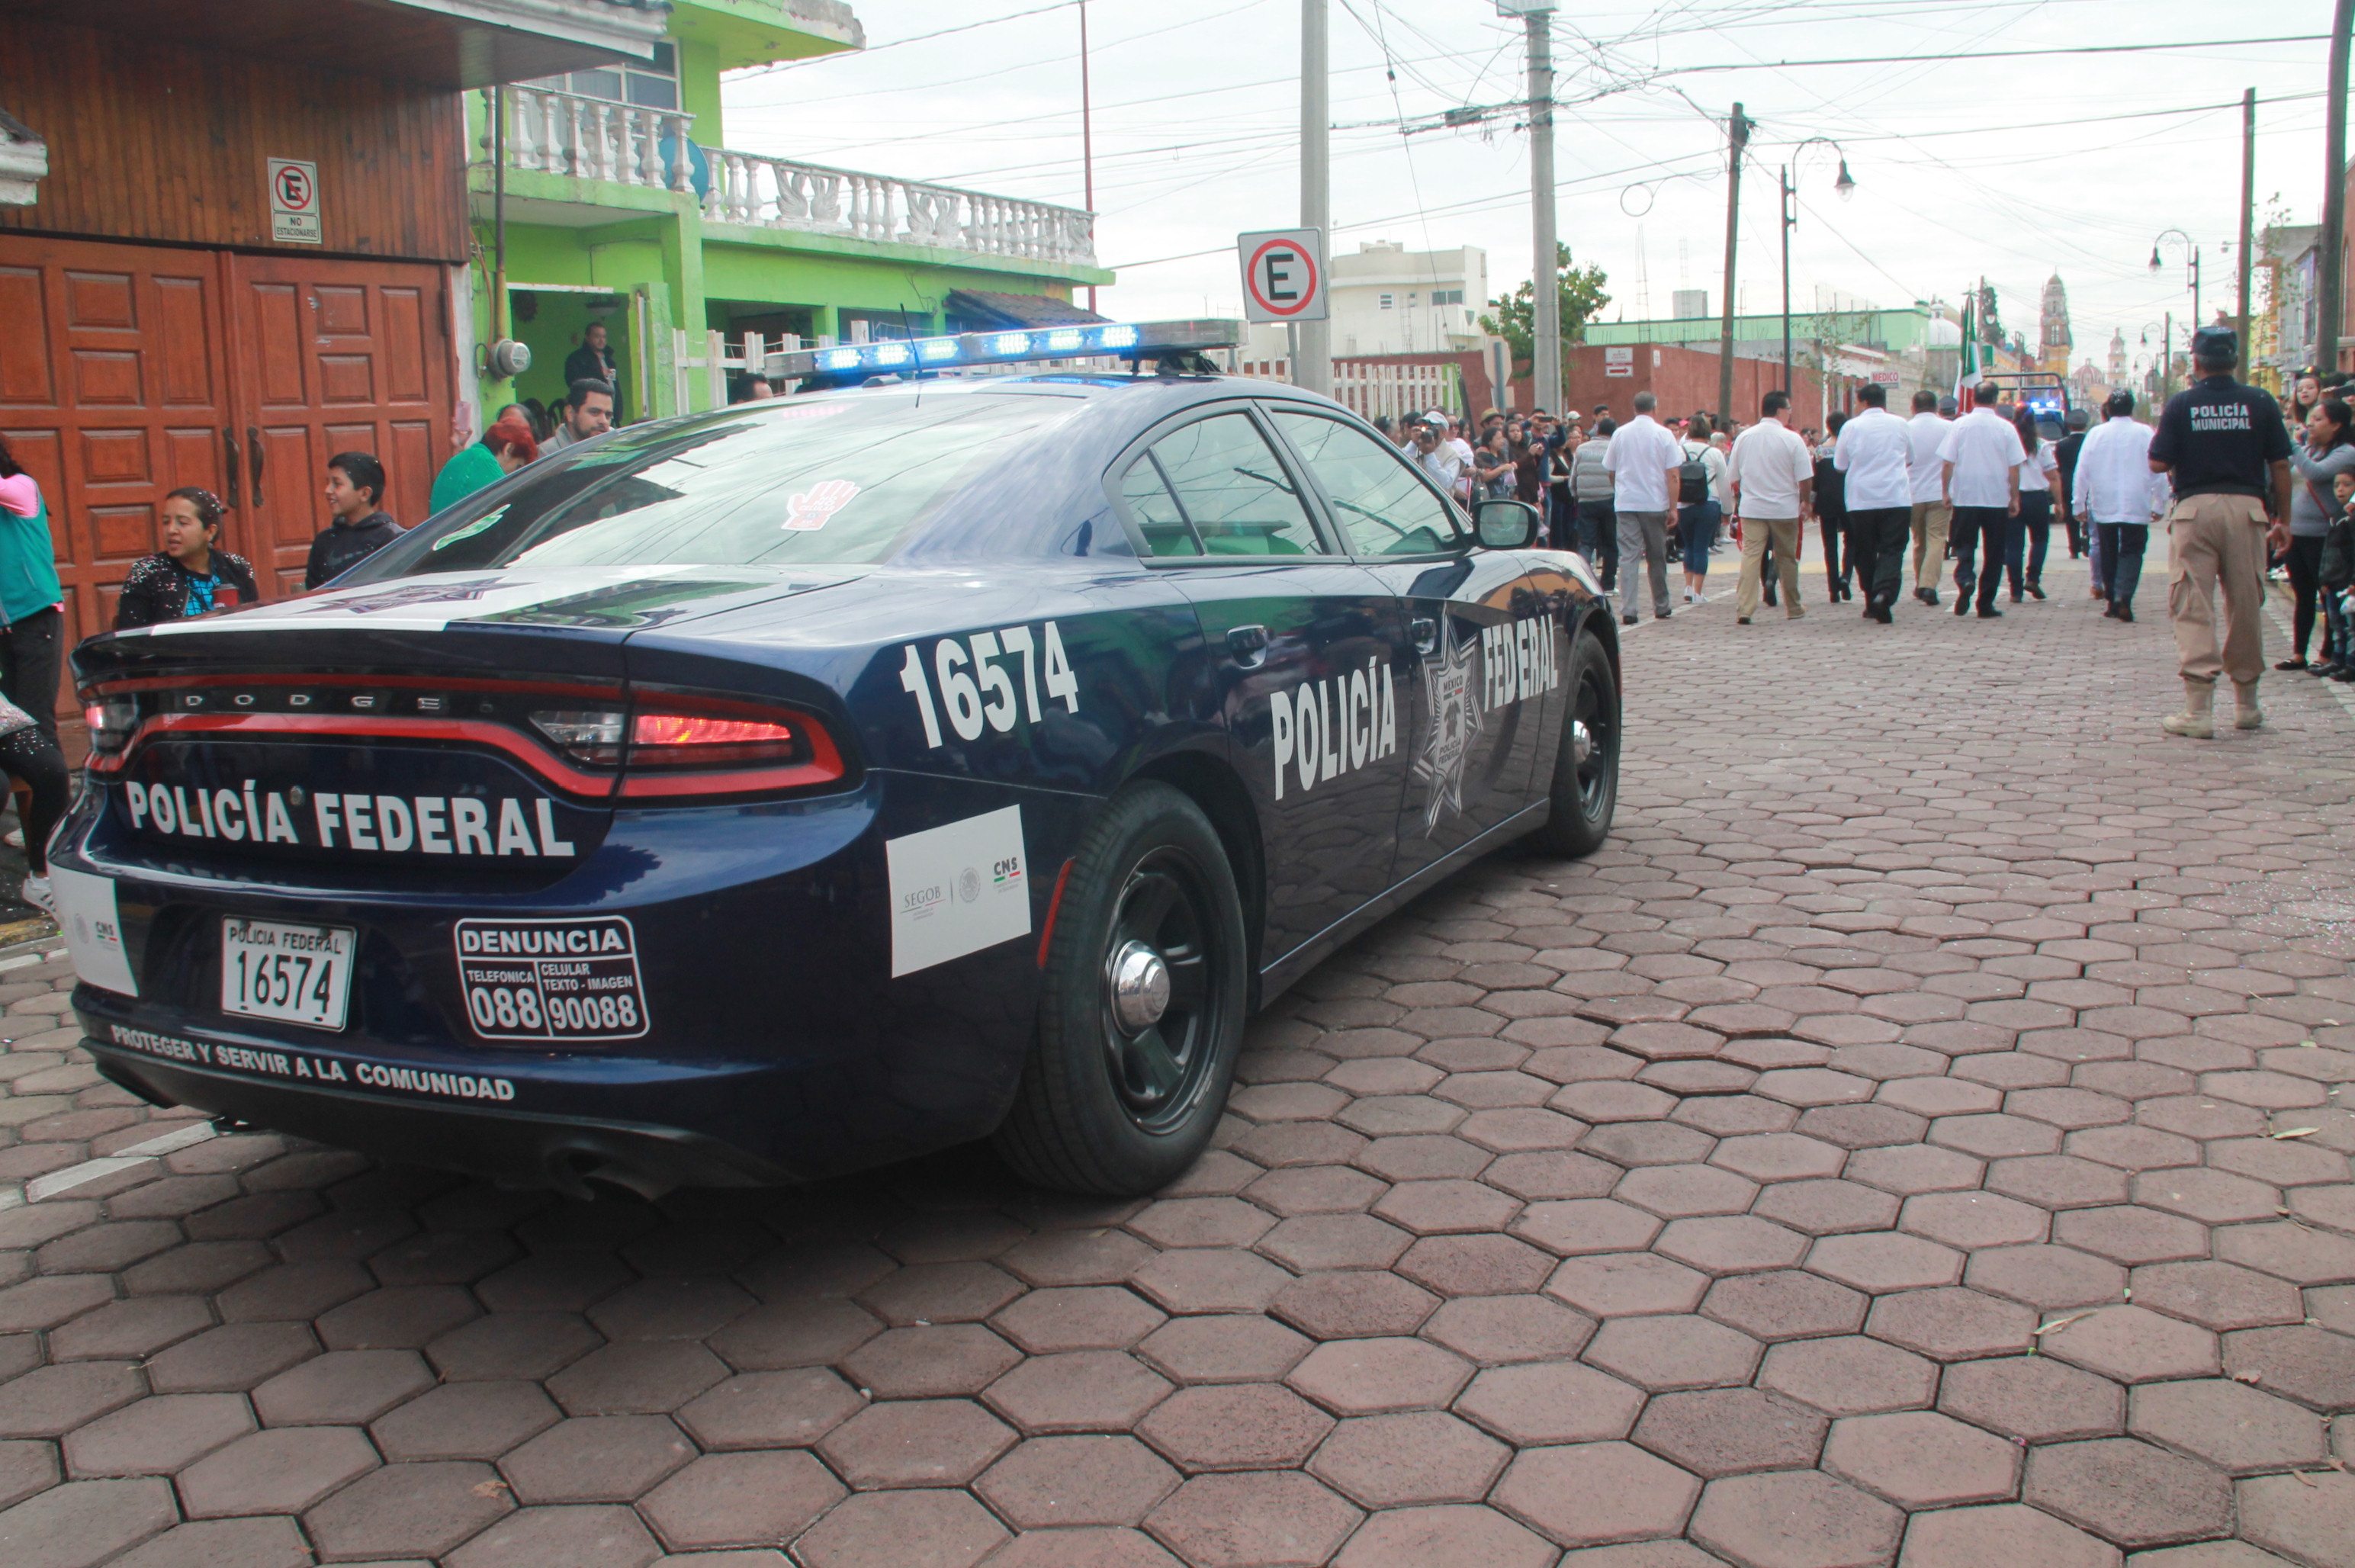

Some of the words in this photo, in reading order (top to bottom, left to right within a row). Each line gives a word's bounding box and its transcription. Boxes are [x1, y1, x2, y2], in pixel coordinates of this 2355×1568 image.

[276, 227, 317, 238] ESTACIONARSE
[290, 217, 302, 227] NO
[1266, 253, 1298, 300] E
[1872, 372, 1899, 382] MEDICO
[2190, 403, 2250, 419] POLICÍA
[2192, 417, 2251, 432] MUNICIPAL
[1482, 614, 1558, 712] FEDERAL
[900, 621, 1079, 749] 16574
[1443, 674, 1463, 693] MÉXICO
[185, 692, 442, 711] DODGE
[1270, 655, 1396, 801] POLICÍA
[1439, 737, 1461, 757] POLICÍA
[1438, 750, 1460, 766] FEDERAL
[126, 779, 298, 844] POLICÍA
[313, 792, 575, 856] FEDERAL
[994, 857, 1018, 876] CNS
[904, 885, 941, 908] SEGOB
[230, 926, 276, 947] POLICIA
[282, 932, 342, 954] FEDERAL
[461, 928, 625, 954] DENUNCIA
[467, 969, 535, 984] TELEFONICA
[540, 962, 591, 977] CELULAR
[238, 950, 333, 1014] 16574
[542, 978, 579, 991] TEXTO
[587, 975, 633, 991] IMAGEN
[471, 987, 543, 1029] 088
[548, 994, 638, 1030] 90088
[111, 1024, 198, 1061] PROTEGER
[197, 1043, 211, 1063] Y
[215, 1045, 291, 1075] SERVIR
[296, 1057, 313, 1078] A
[314, 1059, 347, 1081] LA
[355, 1062, 516, 1101] COMUNIDAD
